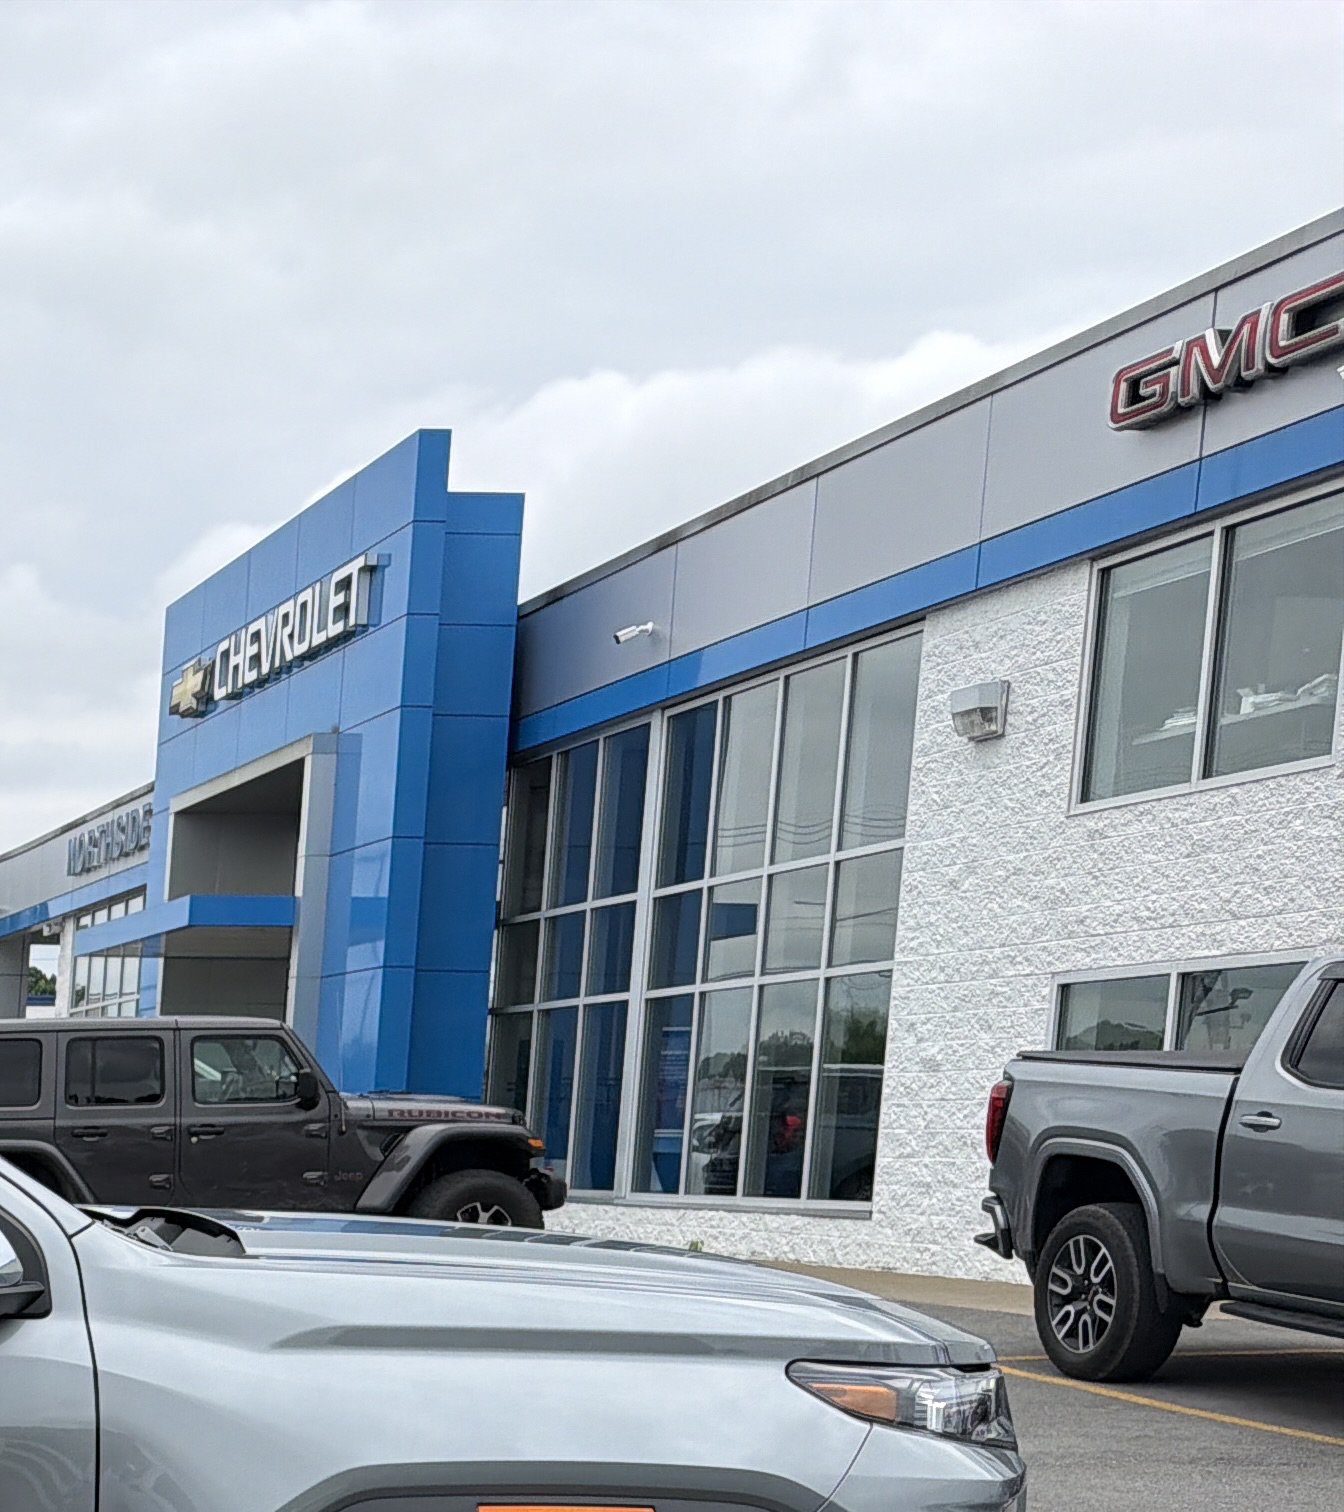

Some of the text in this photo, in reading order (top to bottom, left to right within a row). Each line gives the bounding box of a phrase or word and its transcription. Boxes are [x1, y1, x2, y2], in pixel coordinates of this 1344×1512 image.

[1108, 270, 1344, 431] GMC
[214, 553, 374, 702] CHEVROLET
[66, 801, 153, 877] NORTHSIDE
[387, 1108, 502, 1120] RUBICON
